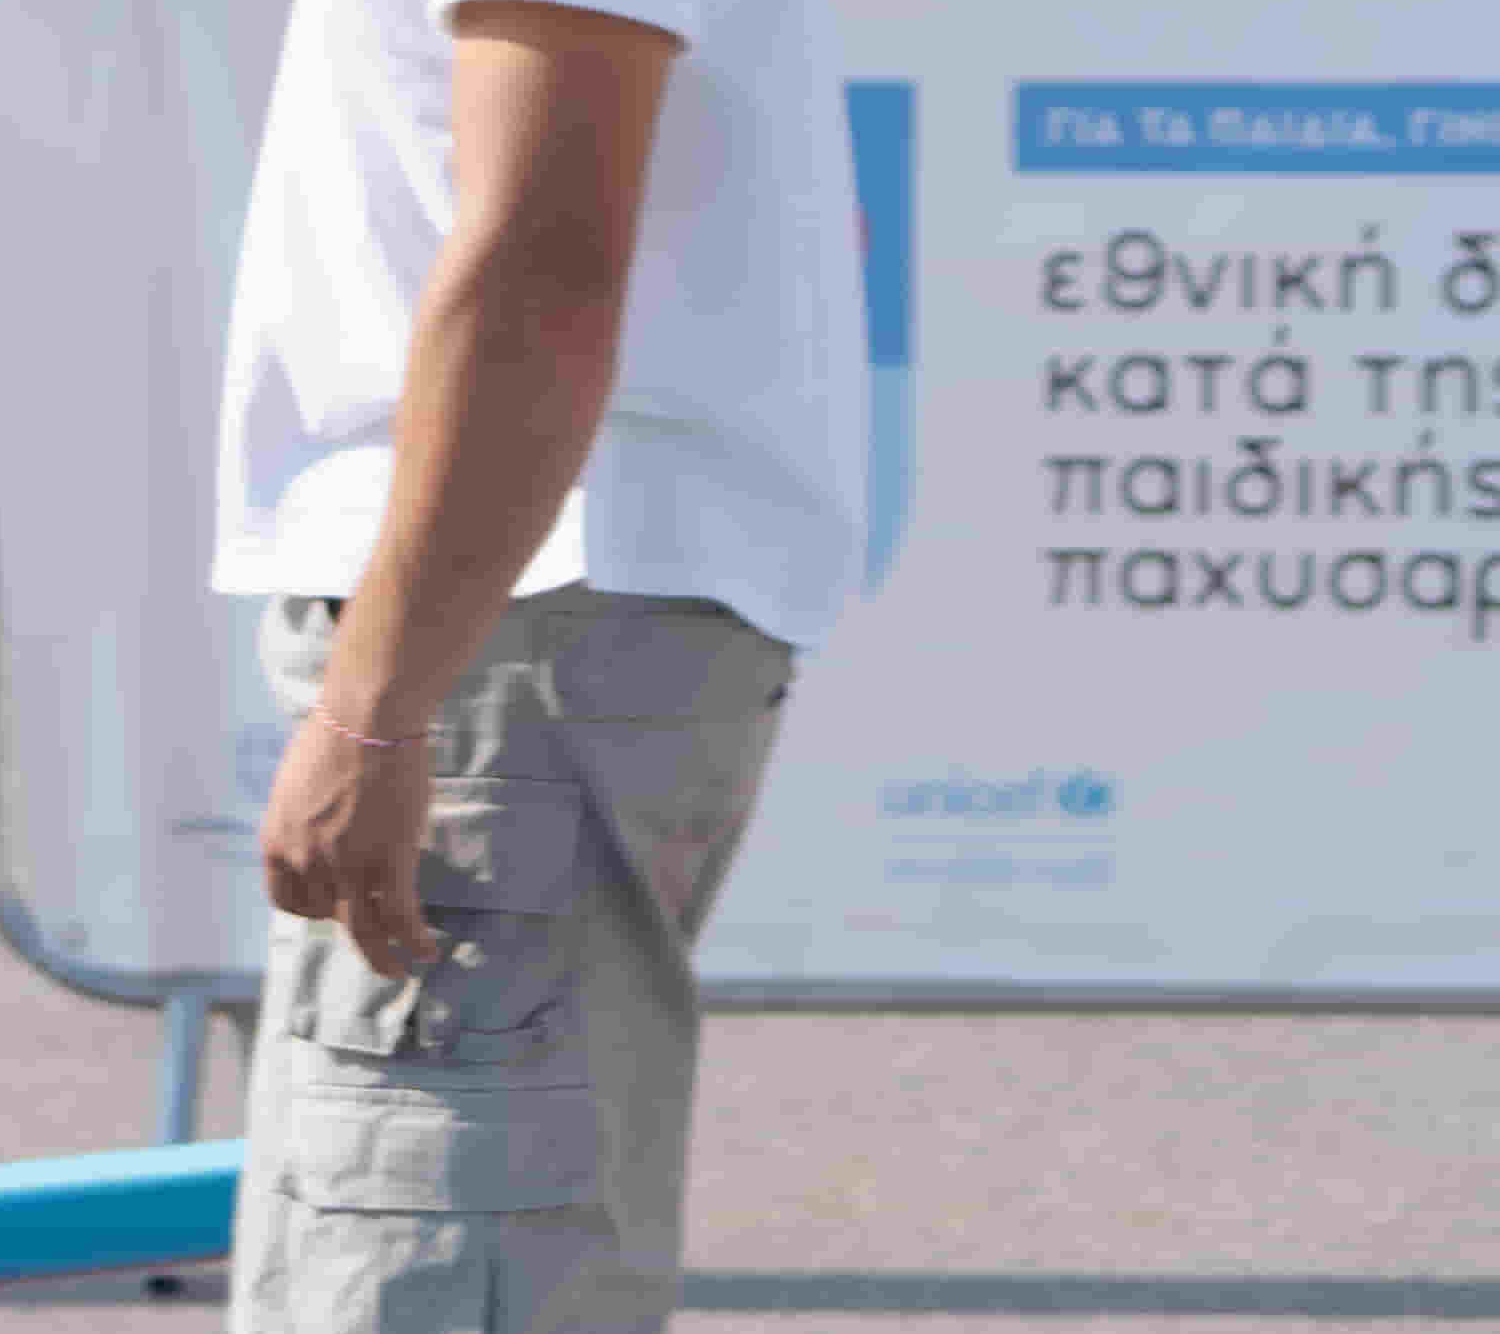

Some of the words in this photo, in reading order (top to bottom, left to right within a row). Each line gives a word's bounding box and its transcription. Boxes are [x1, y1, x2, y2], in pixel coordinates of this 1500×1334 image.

[1042, 223, 1396, 311] εθνική
[1045, 323, 1308, 414] κατά
[1353, 352, 1500, 414] τη
[1045, 548, 1500, 641] παχυσαρ
